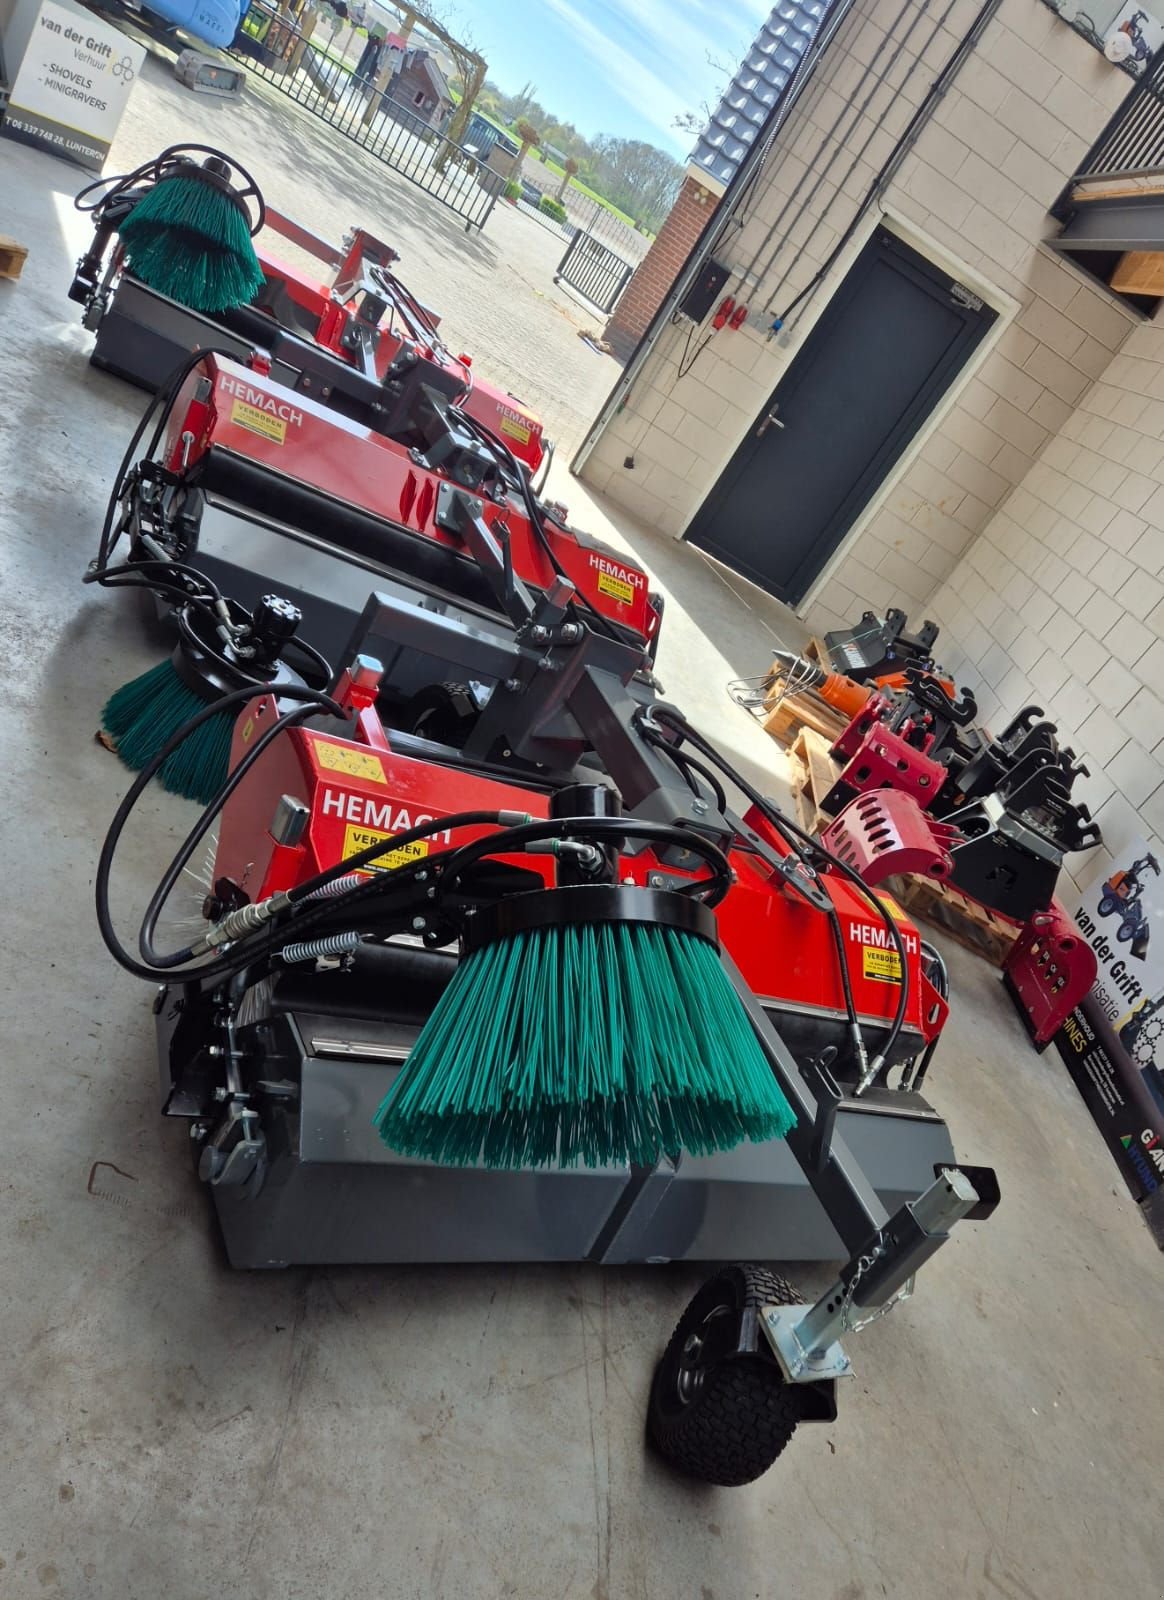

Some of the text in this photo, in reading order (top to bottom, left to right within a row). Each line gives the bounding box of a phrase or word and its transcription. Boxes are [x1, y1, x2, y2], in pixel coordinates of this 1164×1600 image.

[41, 17, 112, 58] van der Grift
[49, 63, 93, 89] SHOVELS
[73, 48, 107, 72] Verhuur
[44, 77, 108, 111] MINIGRAVERS
[5, 116, 12, 126] T
[220, 375, 303, 428] HEMACH
[239, 403, 282, 429] VERBODEN
[496, 402, 540, 435] HEMACH
[589, 553, 644, 590] HEMACH
[352, 832, 421, 856] VERDEN
[850, 922, 917, 955] HEMAH
[1075, 907, 1143, 1005] van der Grift
